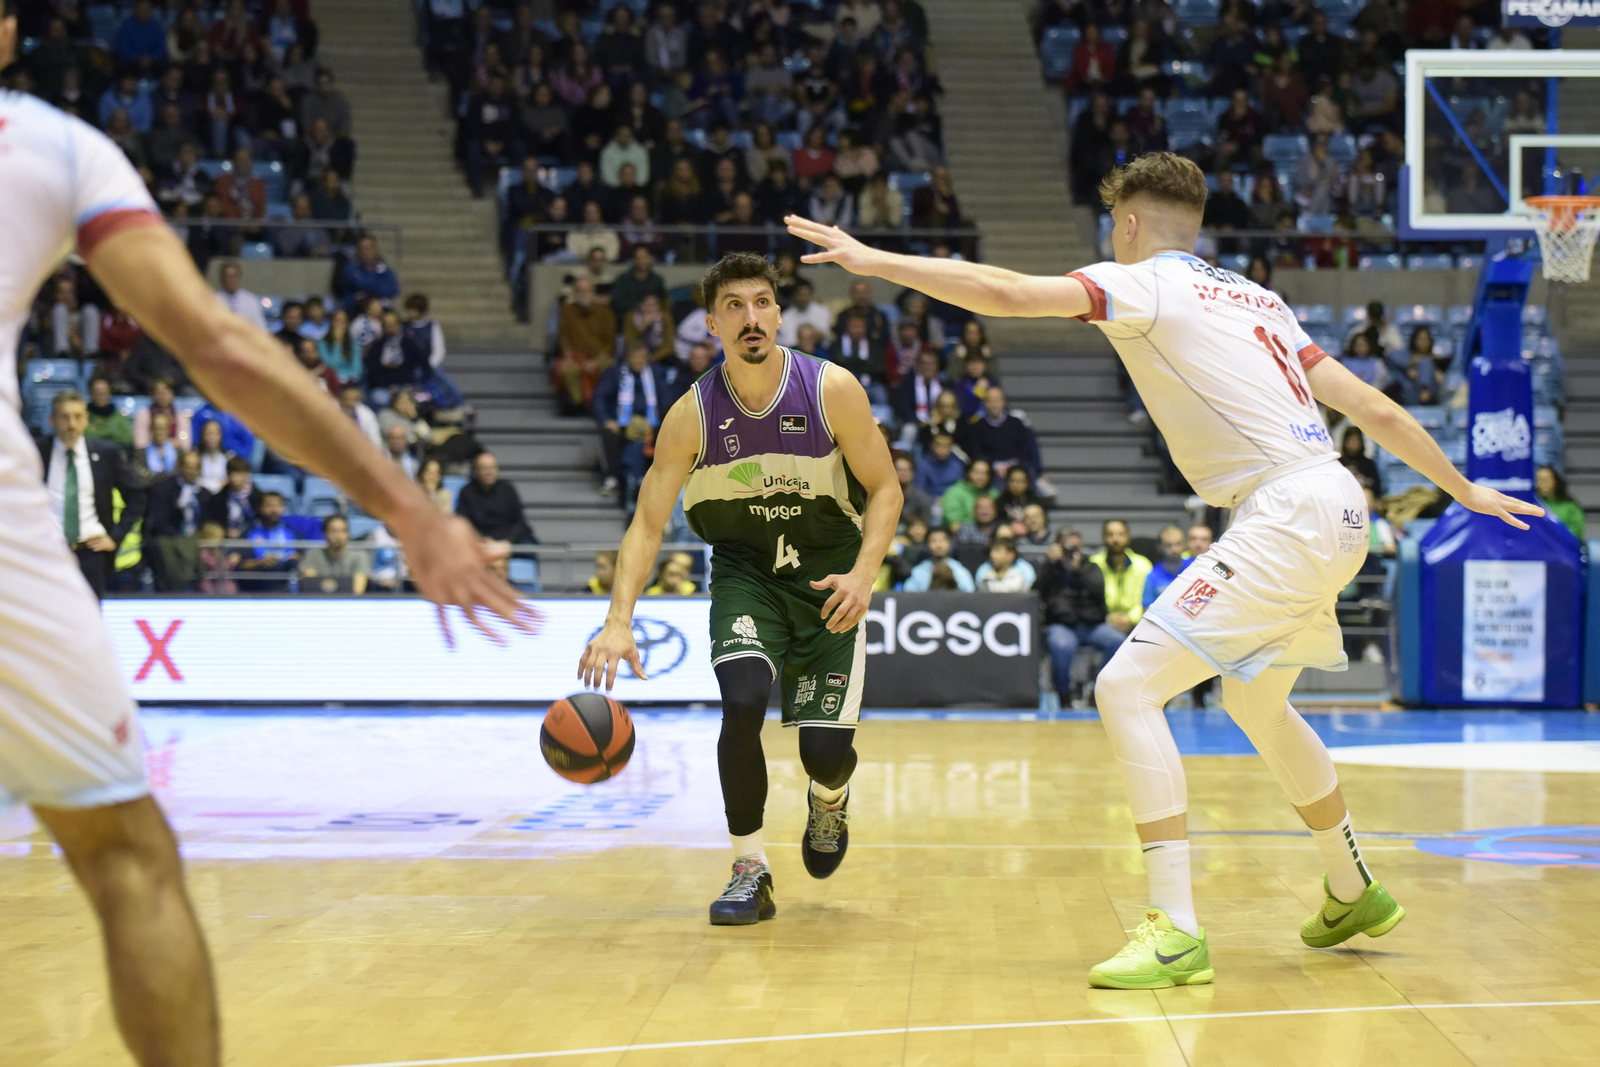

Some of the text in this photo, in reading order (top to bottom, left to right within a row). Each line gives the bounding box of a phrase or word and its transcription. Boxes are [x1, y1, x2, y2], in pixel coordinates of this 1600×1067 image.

[1253, 325, 1313, 409] 11
[763, 474, 811, 491] Unicaja
[772, 534, 802, 575] 4
[828, 677, 842, 685] acb
